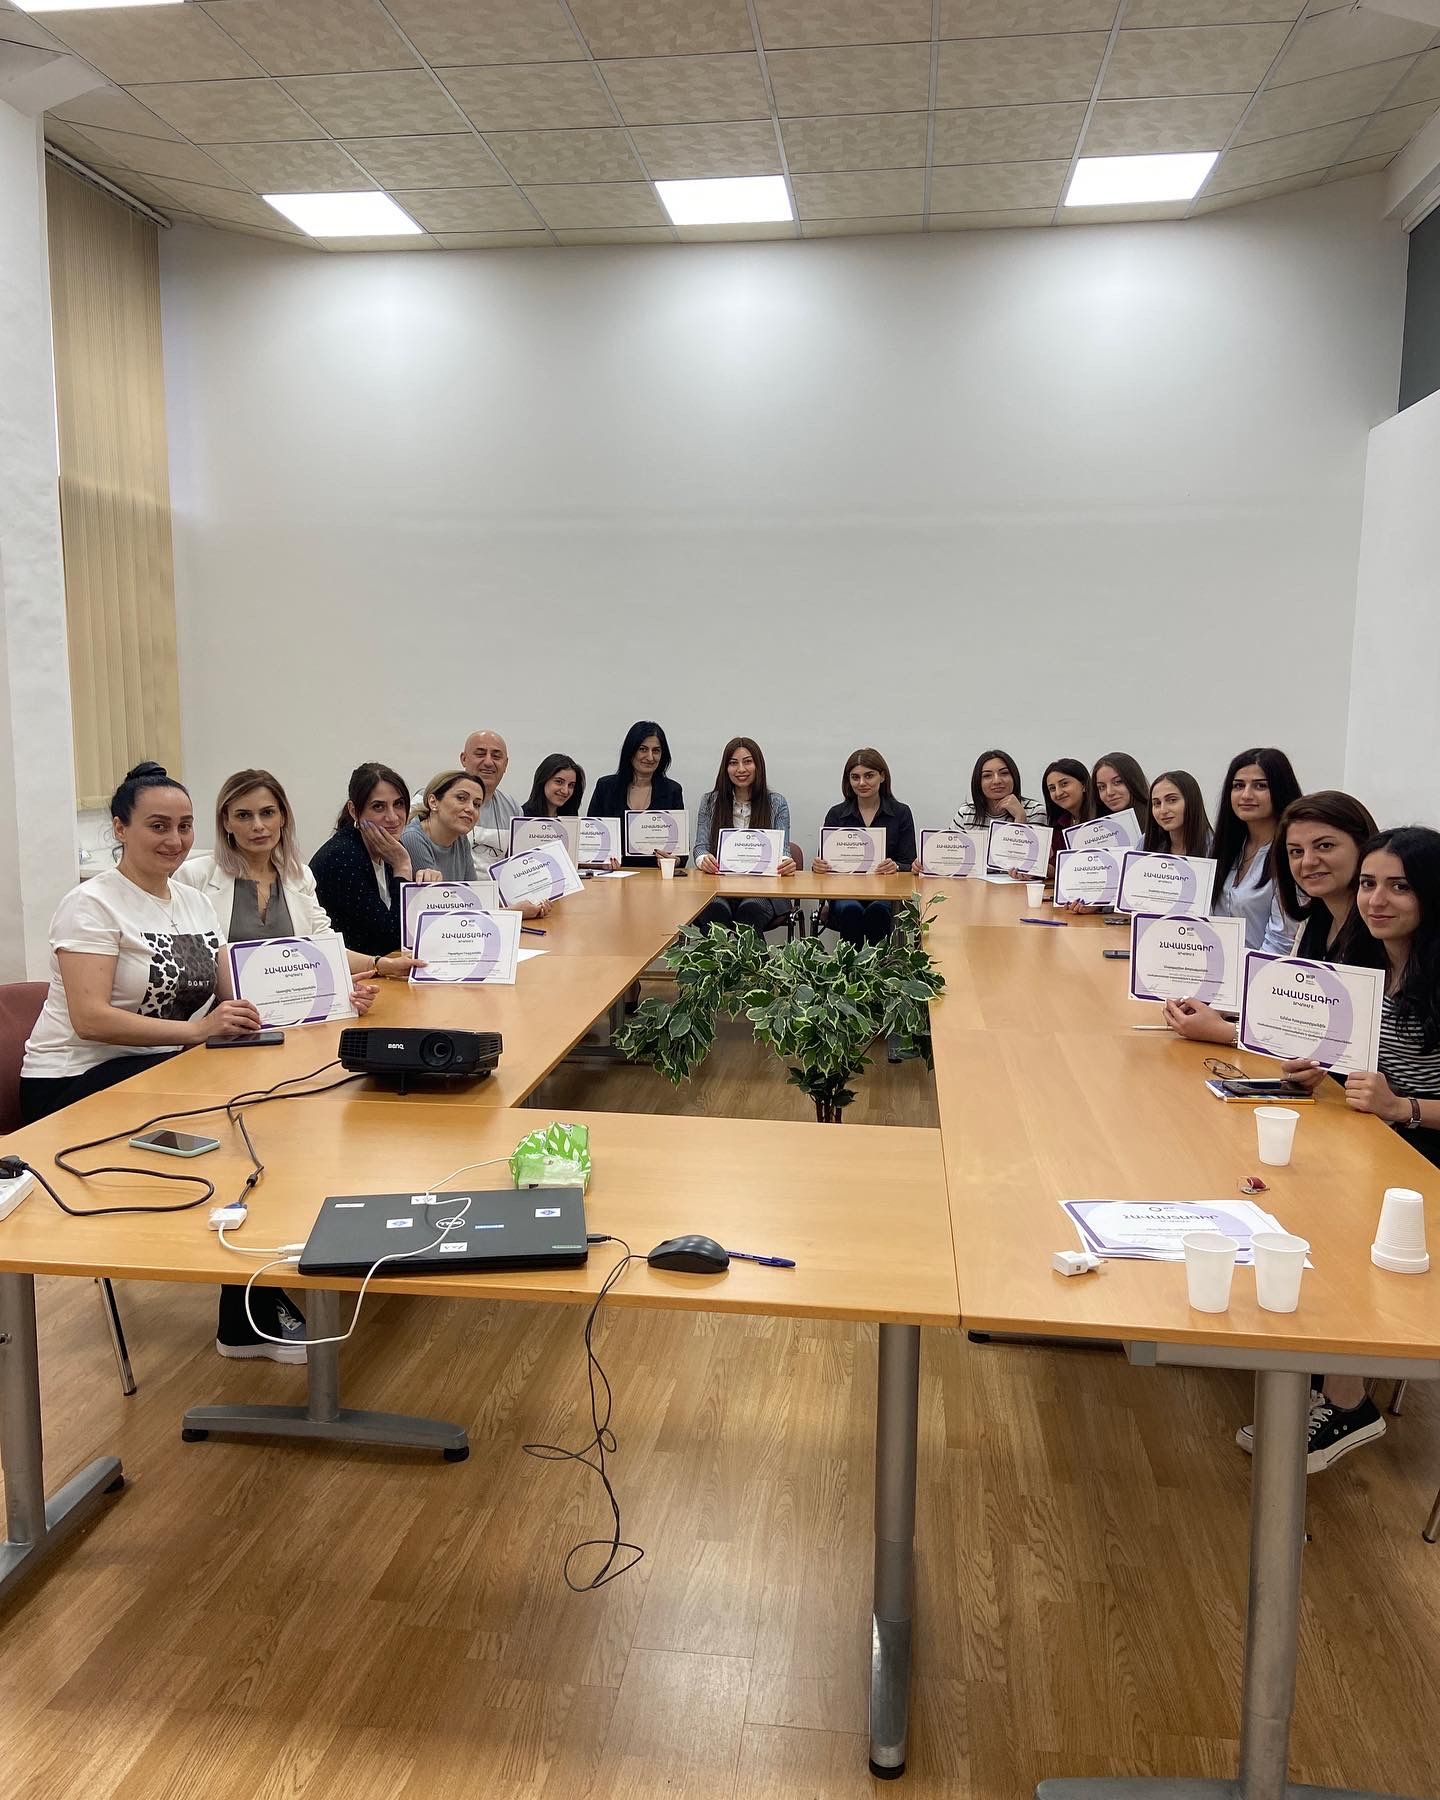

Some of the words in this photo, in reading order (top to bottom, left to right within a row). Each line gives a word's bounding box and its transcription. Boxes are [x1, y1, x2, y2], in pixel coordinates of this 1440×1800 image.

[1084, 831, 1119, 845] ՀԱՎԱՍՏԱԳԻՐ
[513, 861, 551, 879] ՀԱՎԱՍՏԱԳԻՐ
[1143, 871, 1189, 882] ՀԱՎԱՍՏԱԳԻՐ
[1159, 941, 1214, 952] ՀԱՎԱՍՏԱԳԻՐ
[264, 961, 321, 974] ՀԱՎԱՍՏԱԳԻՐ
[1271, 986, 1340, 1006] ՀԱՎԱՍՏԱԳԻՐ
